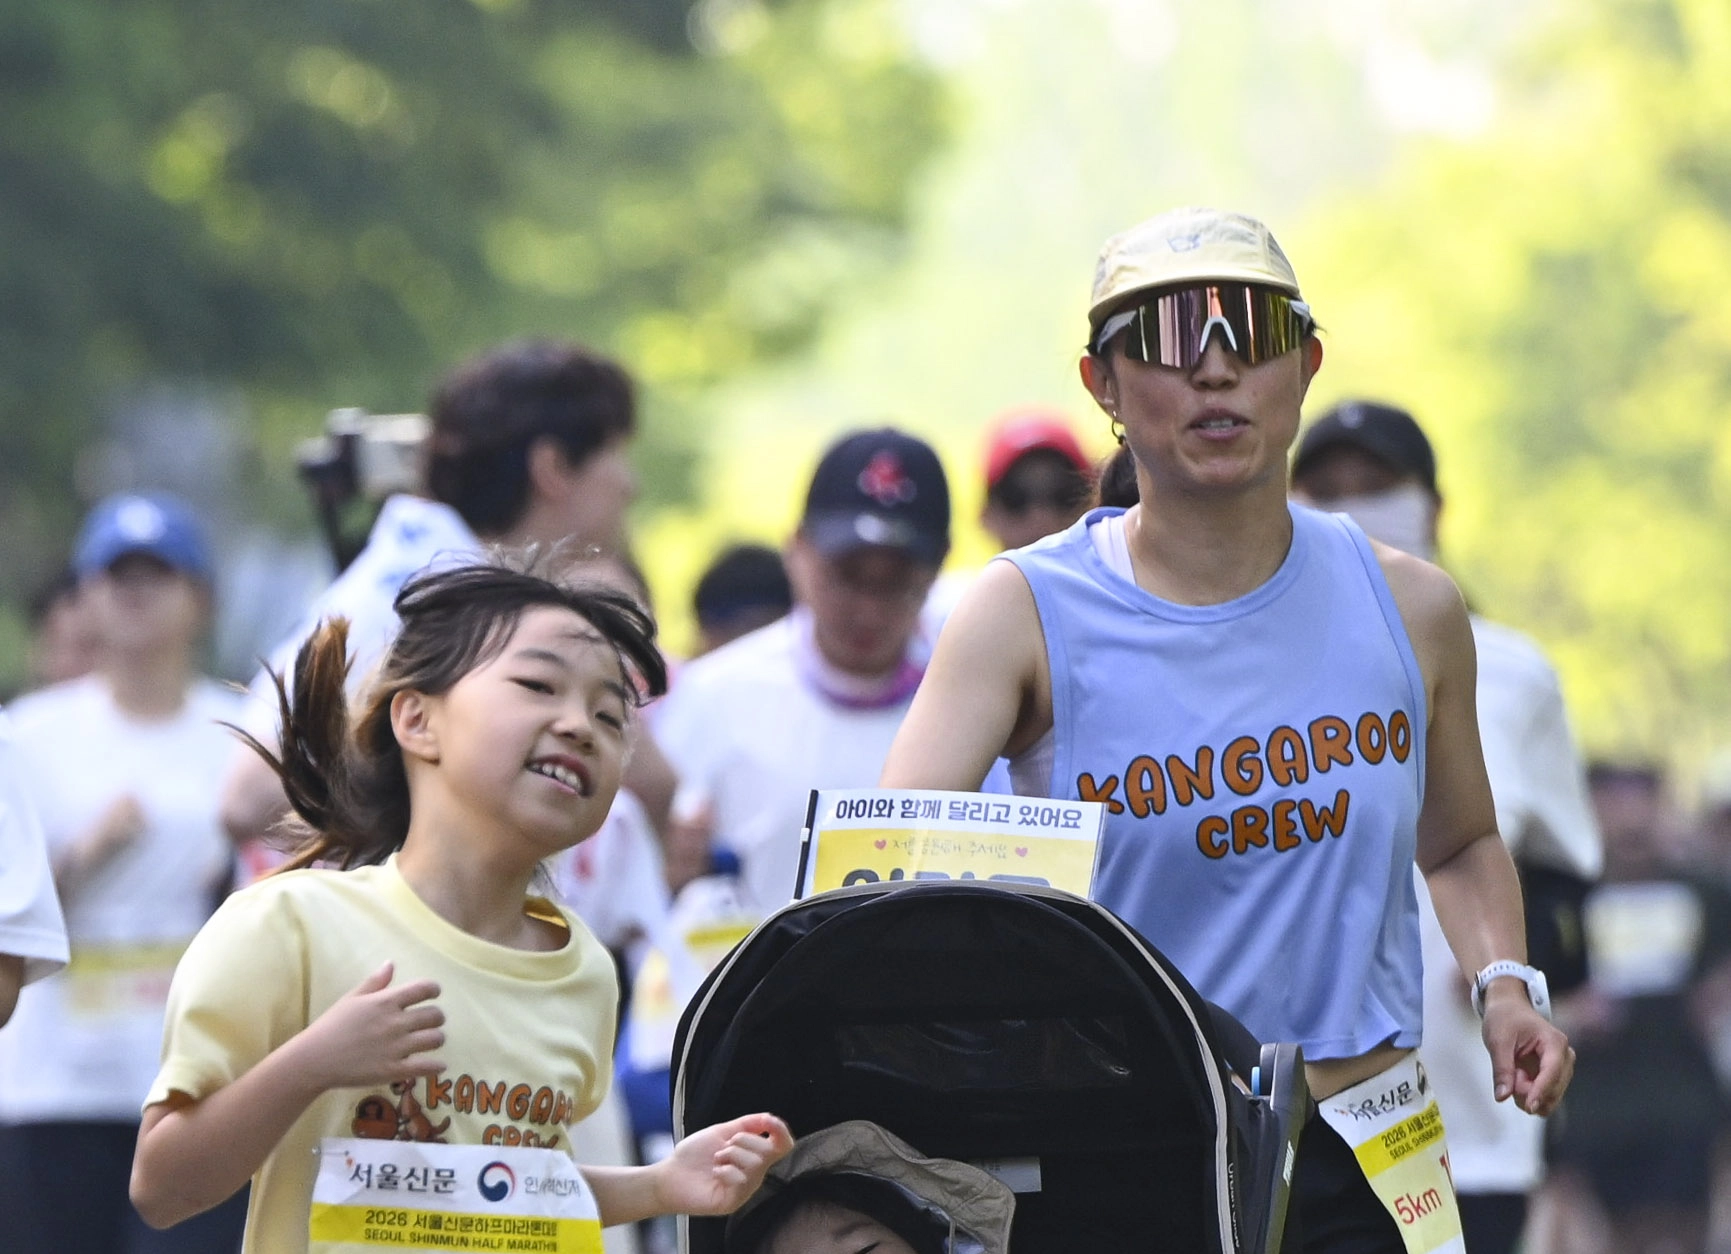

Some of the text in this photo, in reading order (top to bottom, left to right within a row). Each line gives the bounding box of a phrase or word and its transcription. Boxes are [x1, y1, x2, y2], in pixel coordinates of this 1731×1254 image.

[1077, 709, 1412, 818] KANGAROO
[835, 798, 1082, 829] 아이와 함께 달리고 있어요
[1196, 788, 1350, 860] CREW
[350, 1163, 456, 1194] 서울신문
[365, 1209, 407, 1226] 2026
[1393, 1187, 1443, 1225] 5km
[364, 1228, 405, 1242] SEOUL
[409, 1231, 469, 1247] SHINMUN
